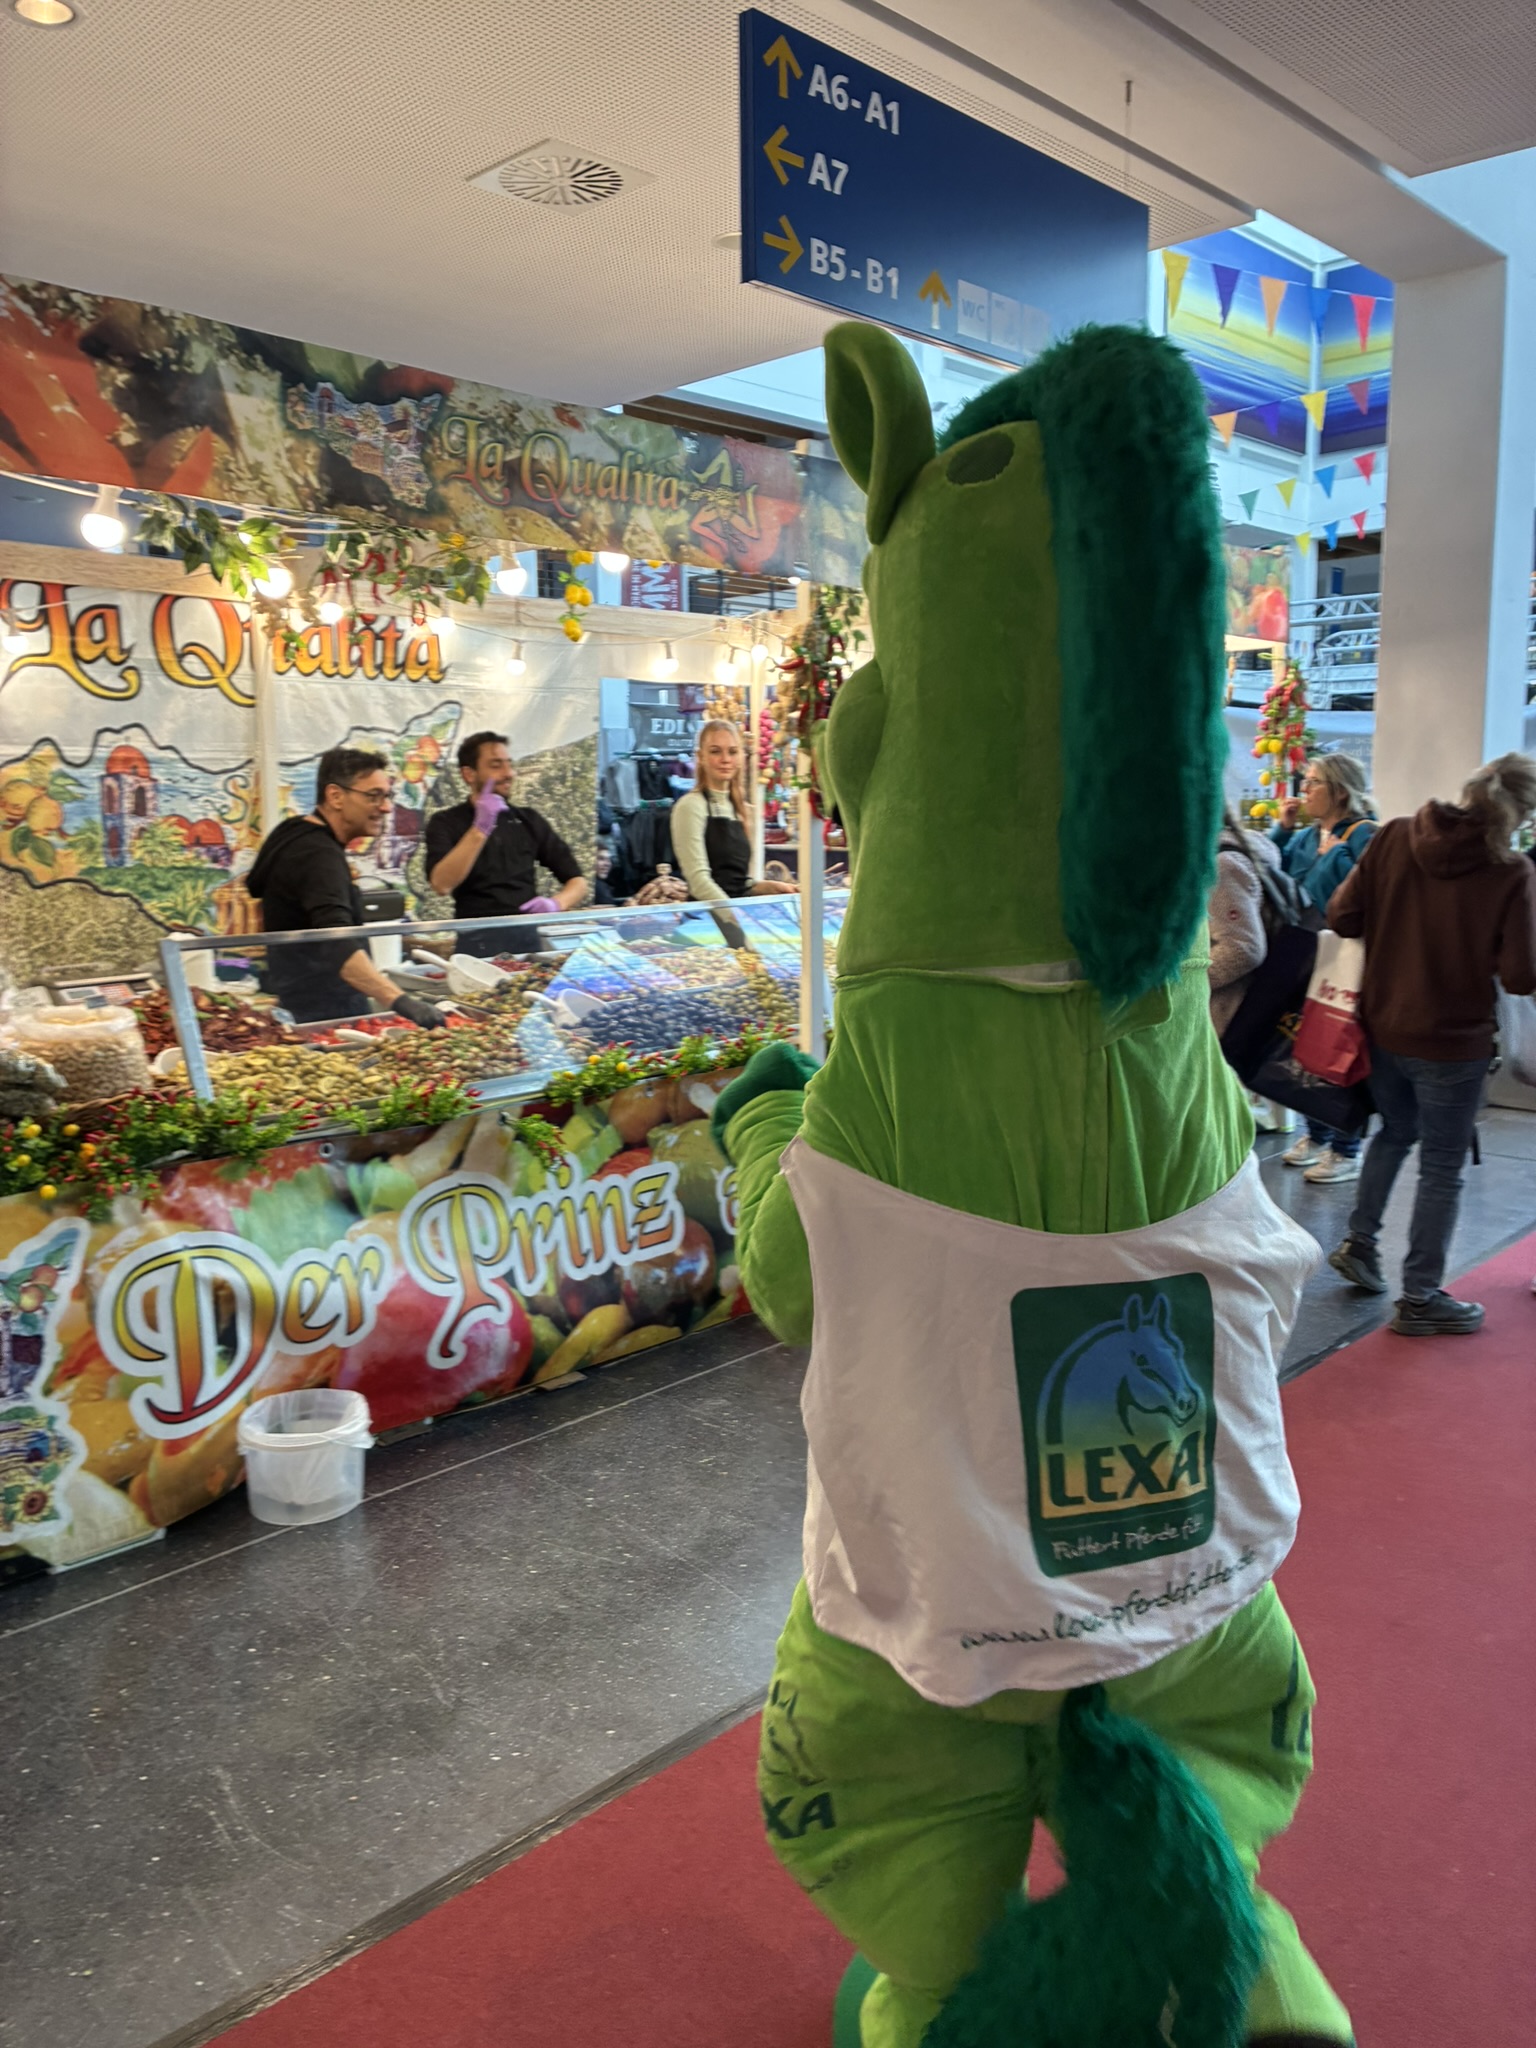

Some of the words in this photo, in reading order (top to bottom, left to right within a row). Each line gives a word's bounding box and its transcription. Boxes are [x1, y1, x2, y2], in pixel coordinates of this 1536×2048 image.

[807, 64, 900, 136] A6-A1
[807, 152, 849, 196] A7
[810, 237, 899, 301] B5-B1
[961, 298, 985, 322] WC
[440, 416, 510, 506] La
[0, 579, 140, 700] La
[111, 1243, 383, 1424] Der
[409, 1165, 671, 1358] Prinz
[1046, 1431, 1203, 1507] LEXA
